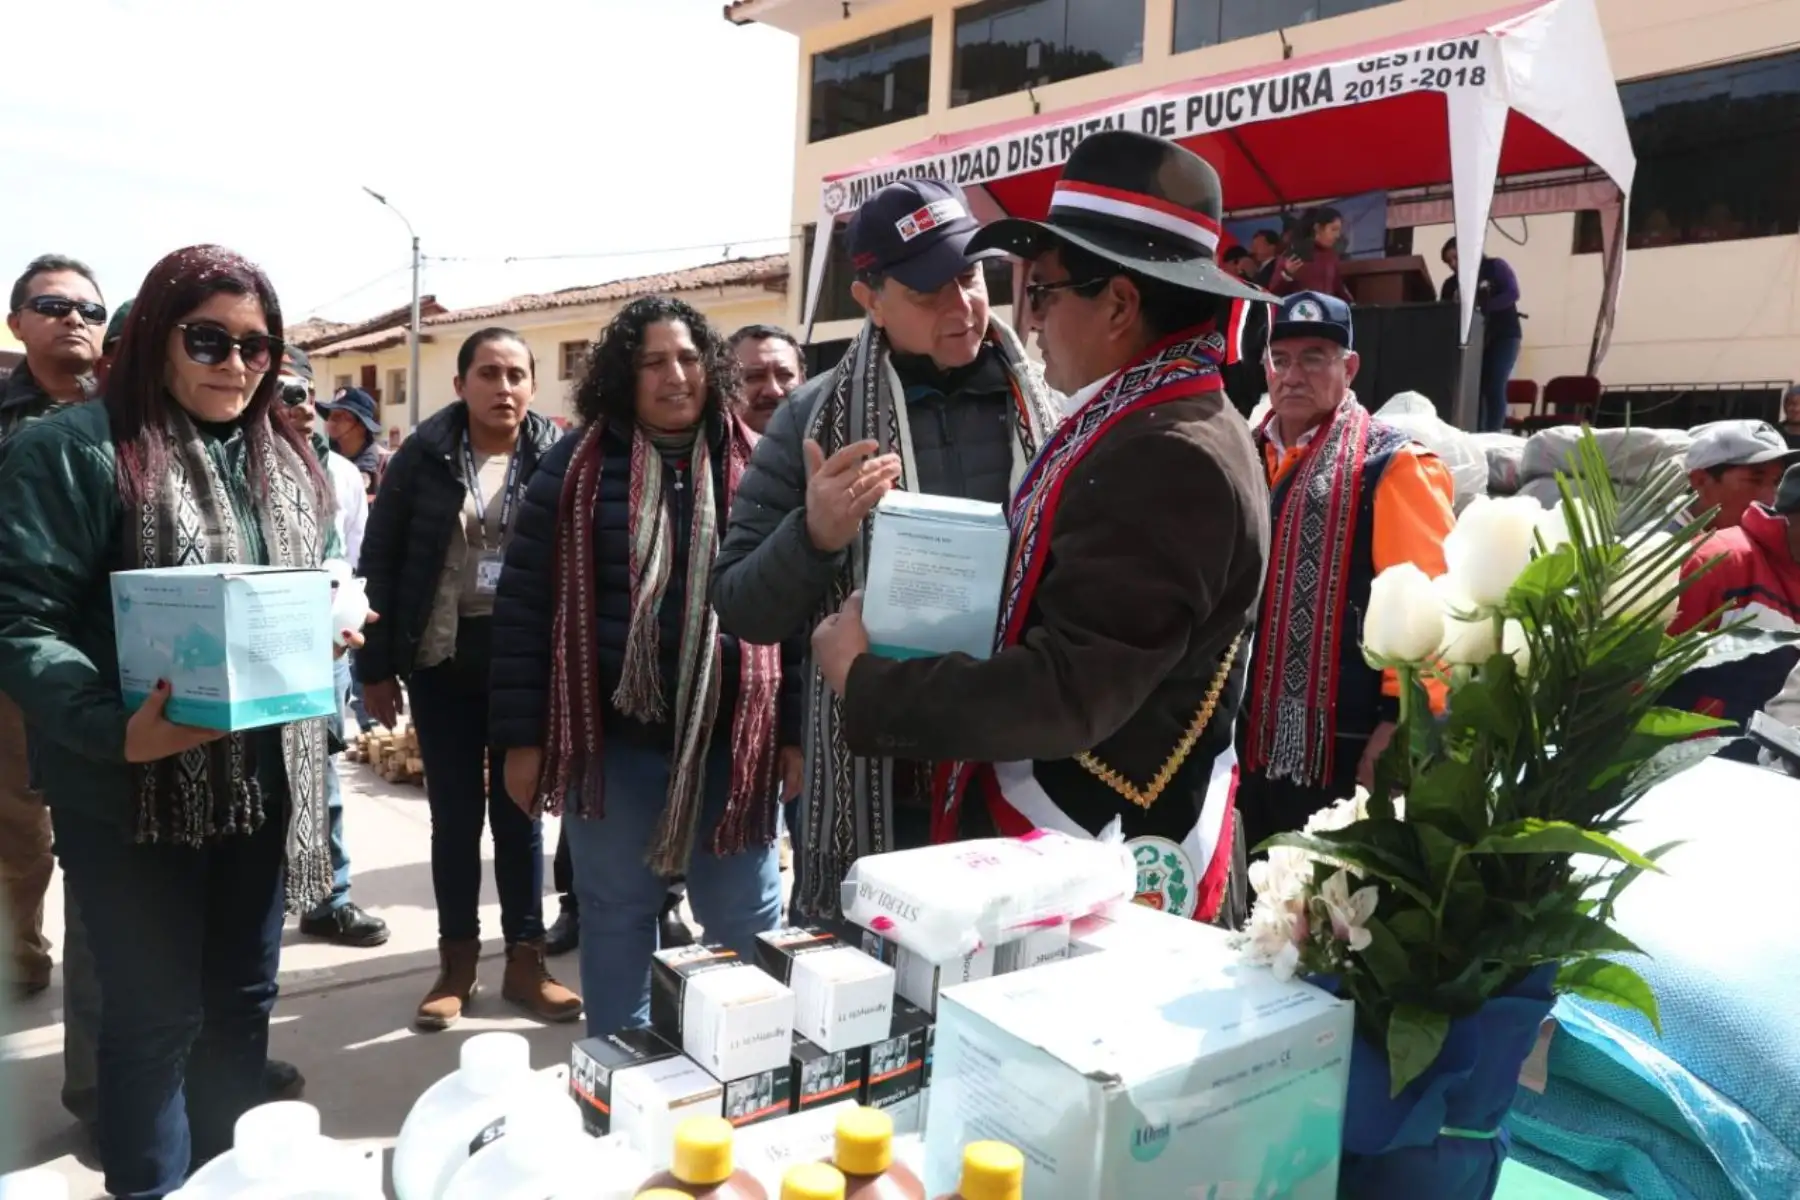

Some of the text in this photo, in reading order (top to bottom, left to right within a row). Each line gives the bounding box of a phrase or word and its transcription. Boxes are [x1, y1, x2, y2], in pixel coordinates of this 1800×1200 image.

[1141, 101, 1176, 137] DE
[1186, 67, 1334, 132] PUCYURA
[1343, 73, 1403, 102] 2015
